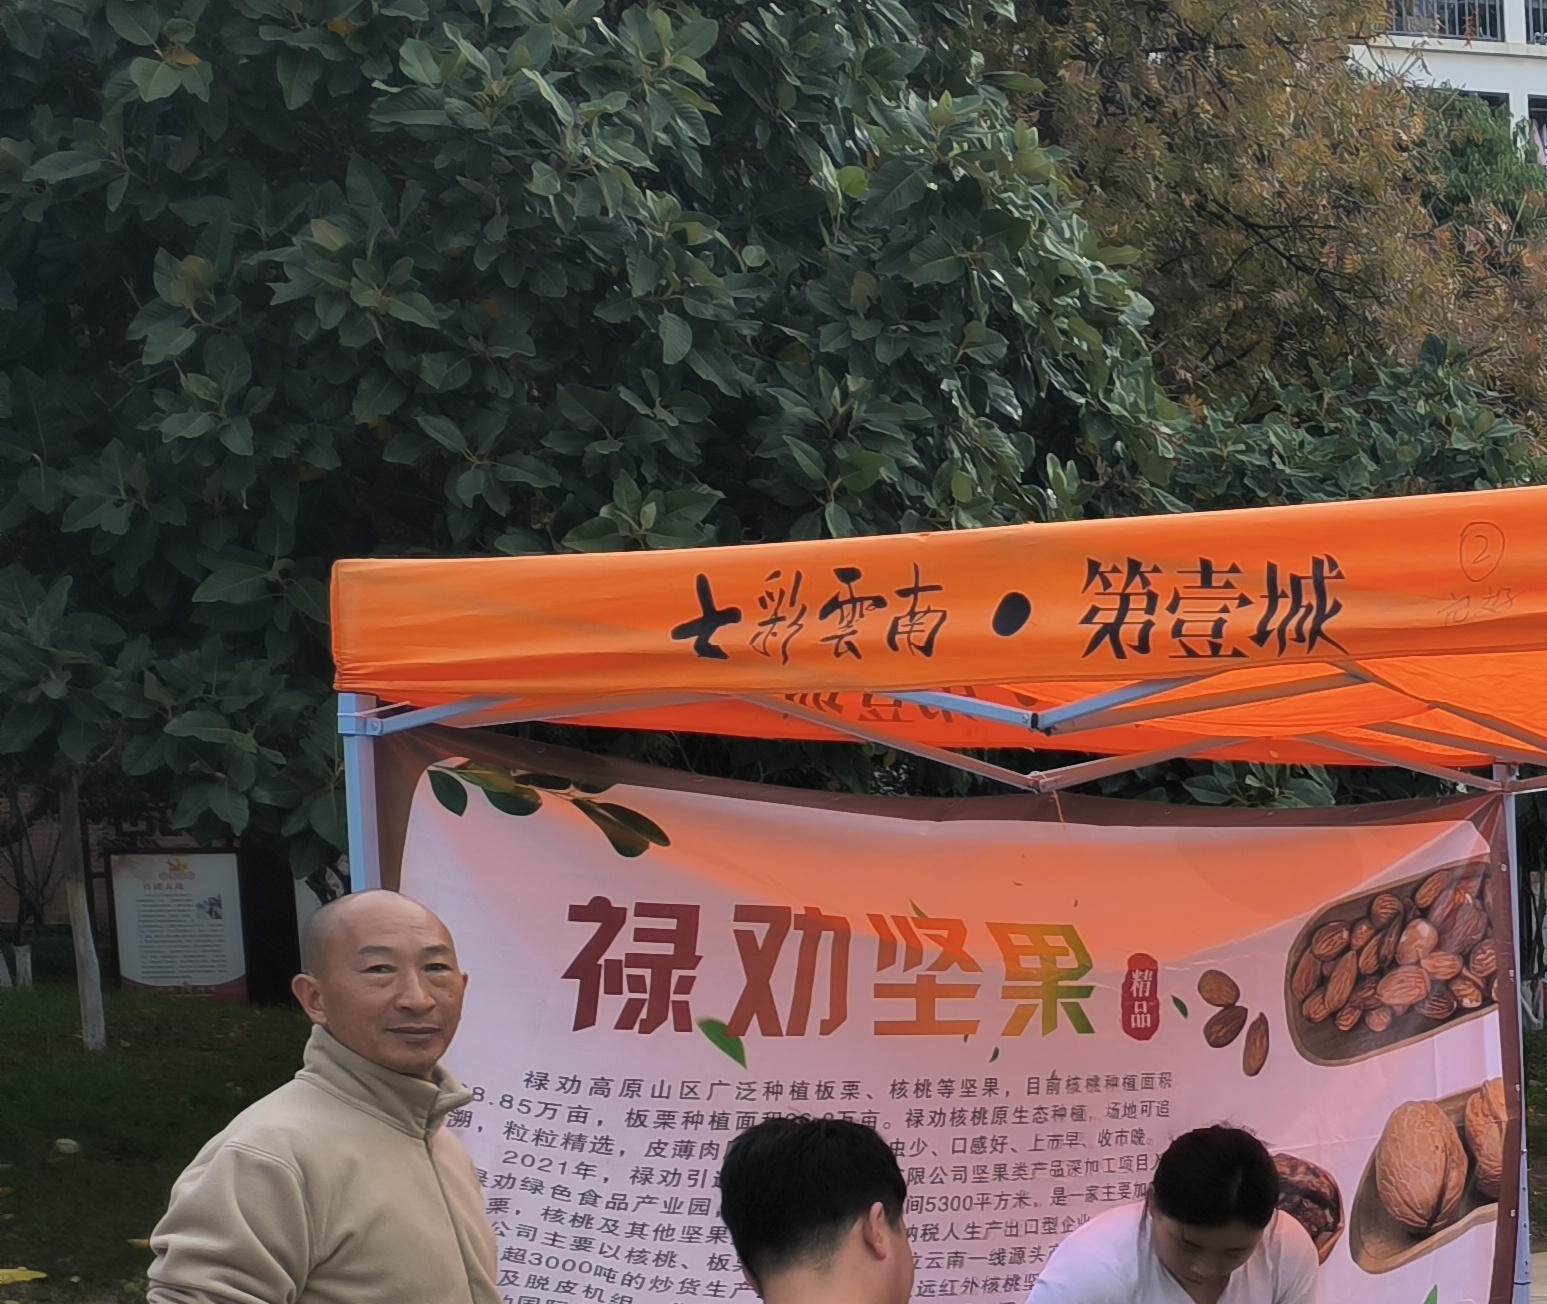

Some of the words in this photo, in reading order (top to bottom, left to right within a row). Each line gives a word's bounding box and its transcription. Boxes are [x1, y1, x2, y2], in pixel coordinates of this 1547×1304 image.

[1077, 553, 1347, 661] 第壹城
[561, 895, 1098, 1037] 禄劝坚果
[1129, 966, 1154, 1032] 精品
[899, 1152, 1161, 1186] 限公司坚果类产品深加工项目
